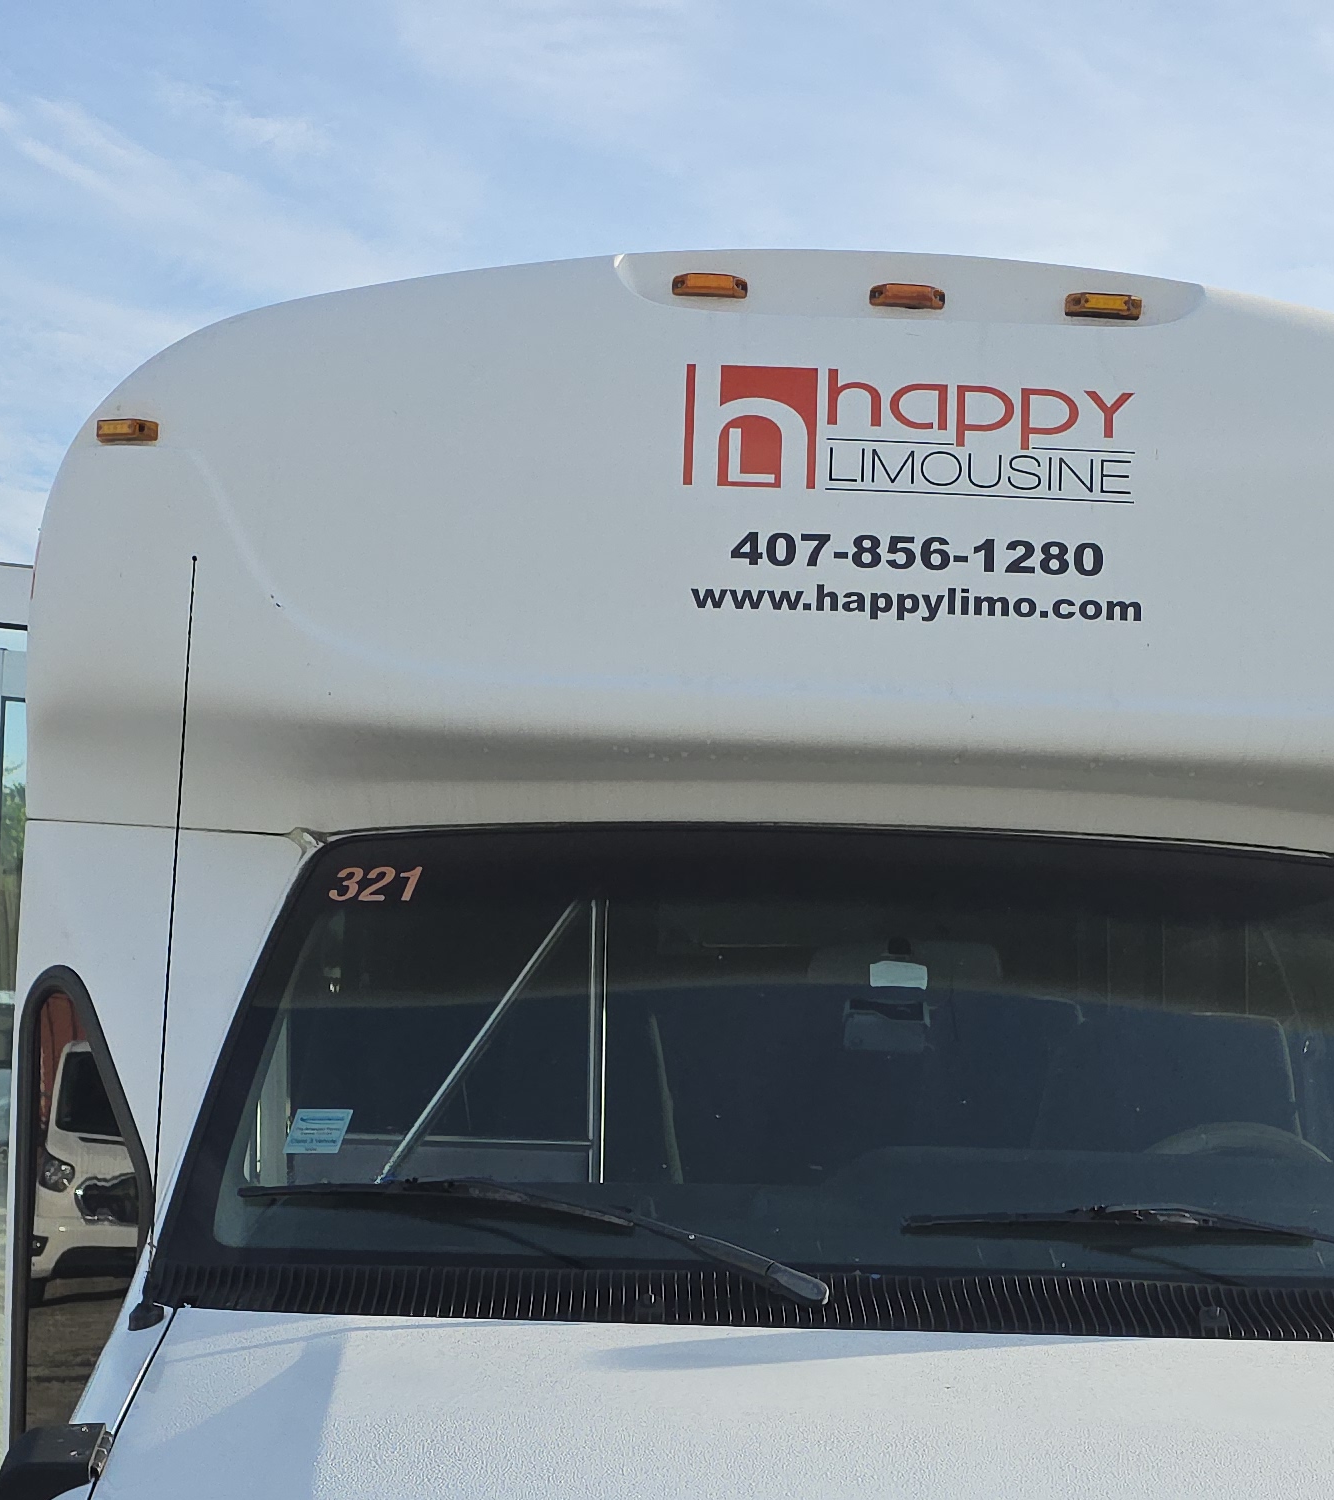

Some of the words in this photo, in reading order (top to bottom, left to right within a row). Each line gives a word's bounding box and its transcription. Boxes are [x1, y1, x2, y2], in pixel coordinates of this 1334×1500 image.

[828, 446, 1132, 495] LIMOUSINE
[730, 531, 1105, 577] 407-856-1280
[690, 584, 1142, 622] www.happylimo.com
[328, 866, 423, 901] 321
